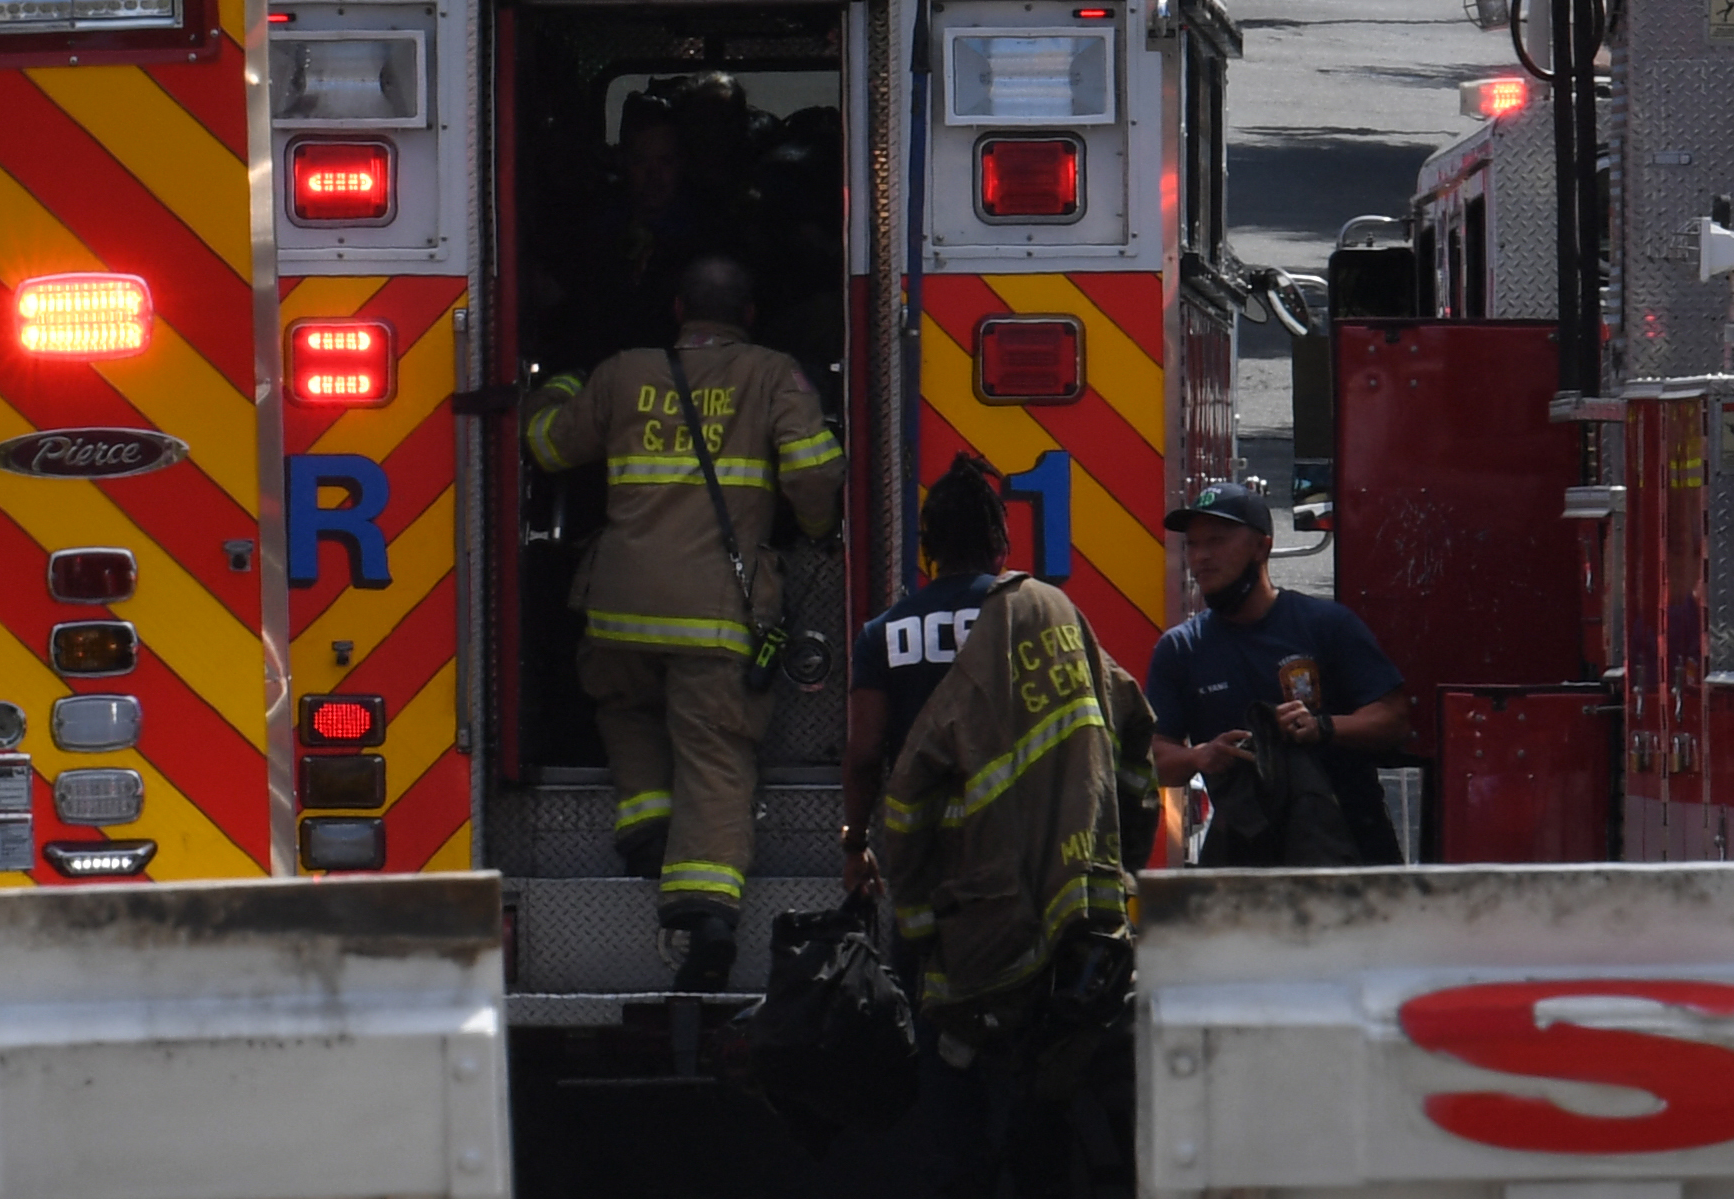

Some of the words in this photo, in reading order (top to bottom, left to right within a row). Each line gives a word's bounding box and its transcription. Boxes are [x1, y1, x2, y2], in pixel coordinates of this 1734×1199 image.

[31, 435, 143, 471] Pierce
[643, 419, 665, 451] &
[287, 455, 392, 589] R
[1003, 449, 1072, 583] 1
